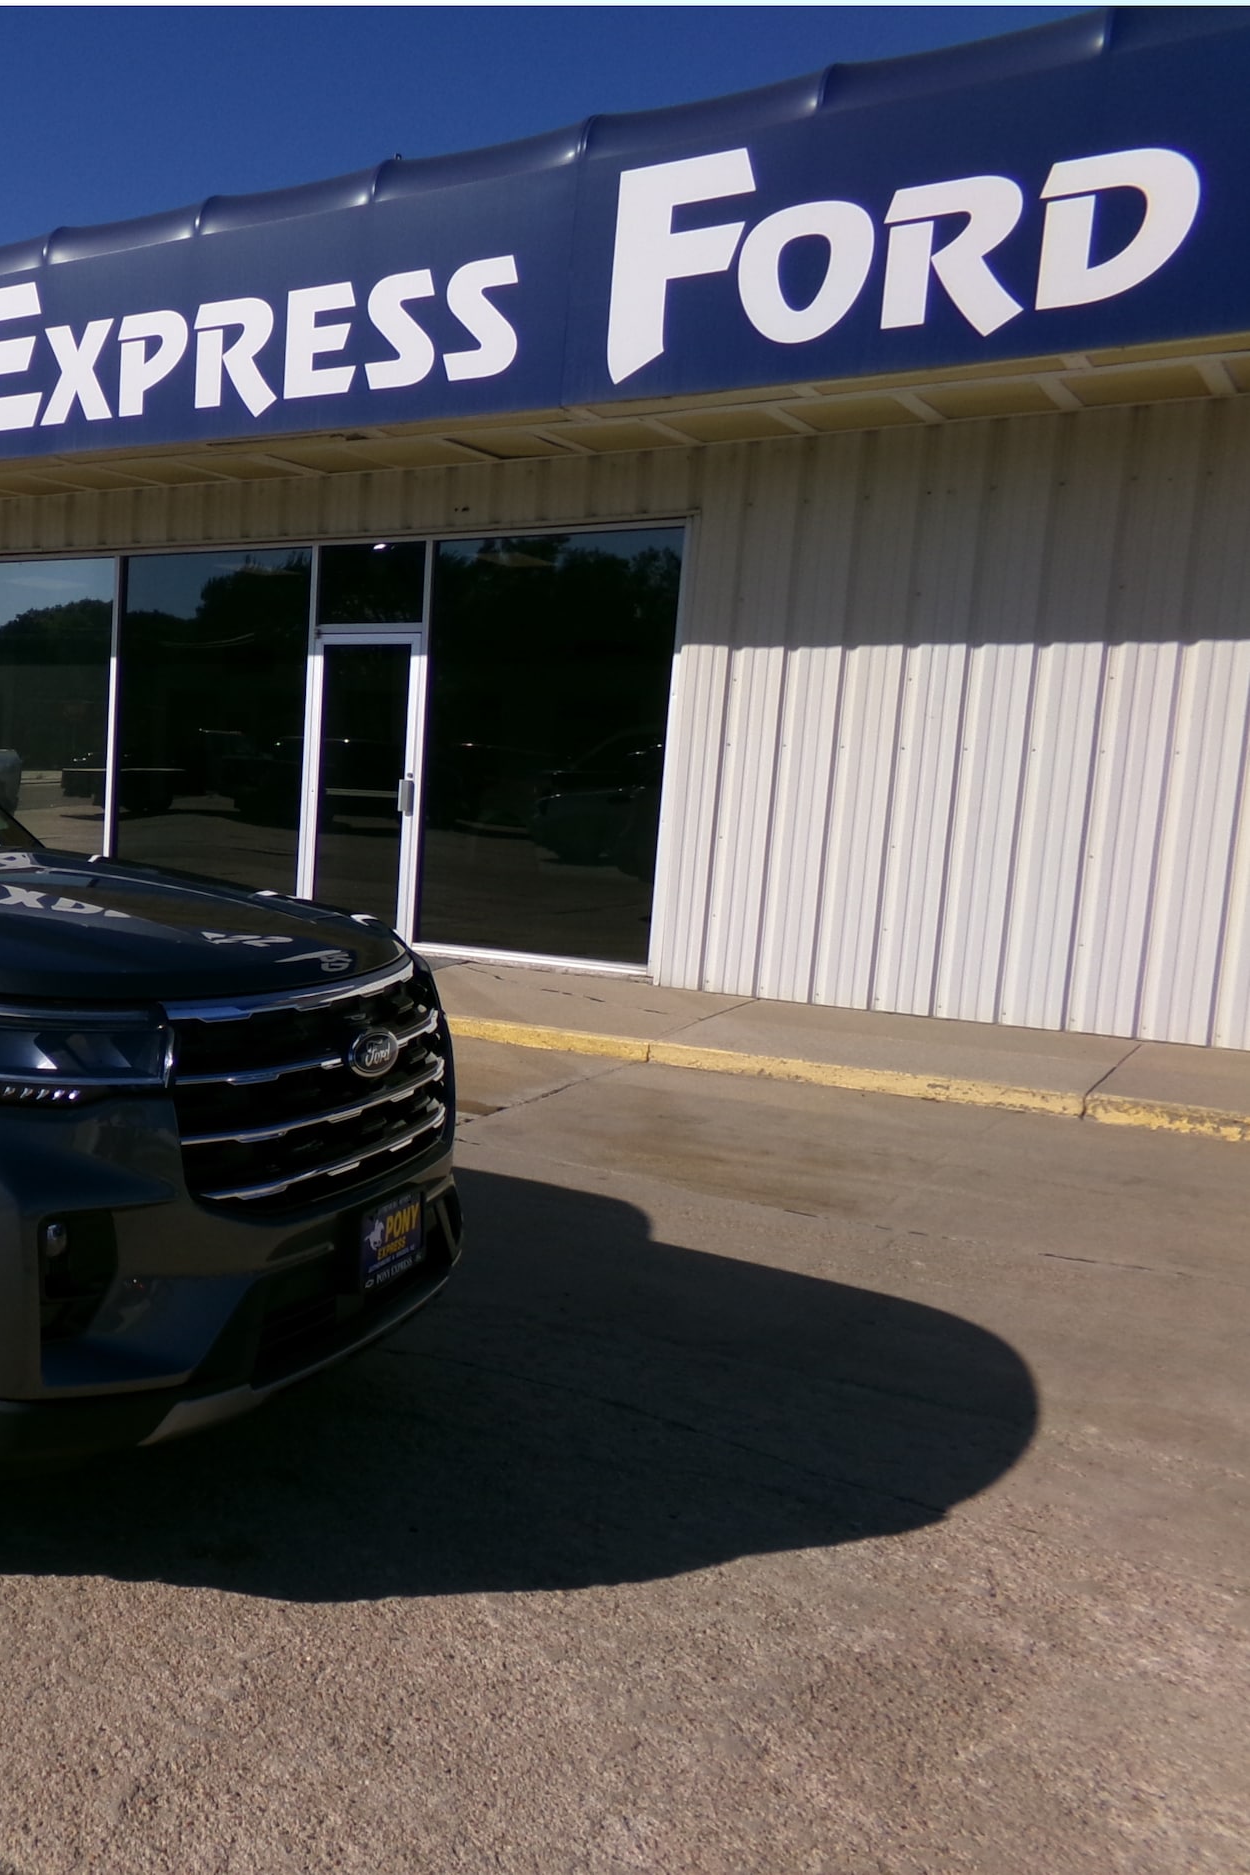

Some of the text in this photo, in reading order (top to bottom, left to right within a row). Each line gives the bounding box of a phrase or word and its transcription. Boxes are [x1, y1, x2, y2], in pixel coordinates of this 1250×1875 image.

[607, 147, 1200, 385] FORD
[384, 1202, 420, 1242] PONY
[376, 1236, 407, 1260] EXPRESS
